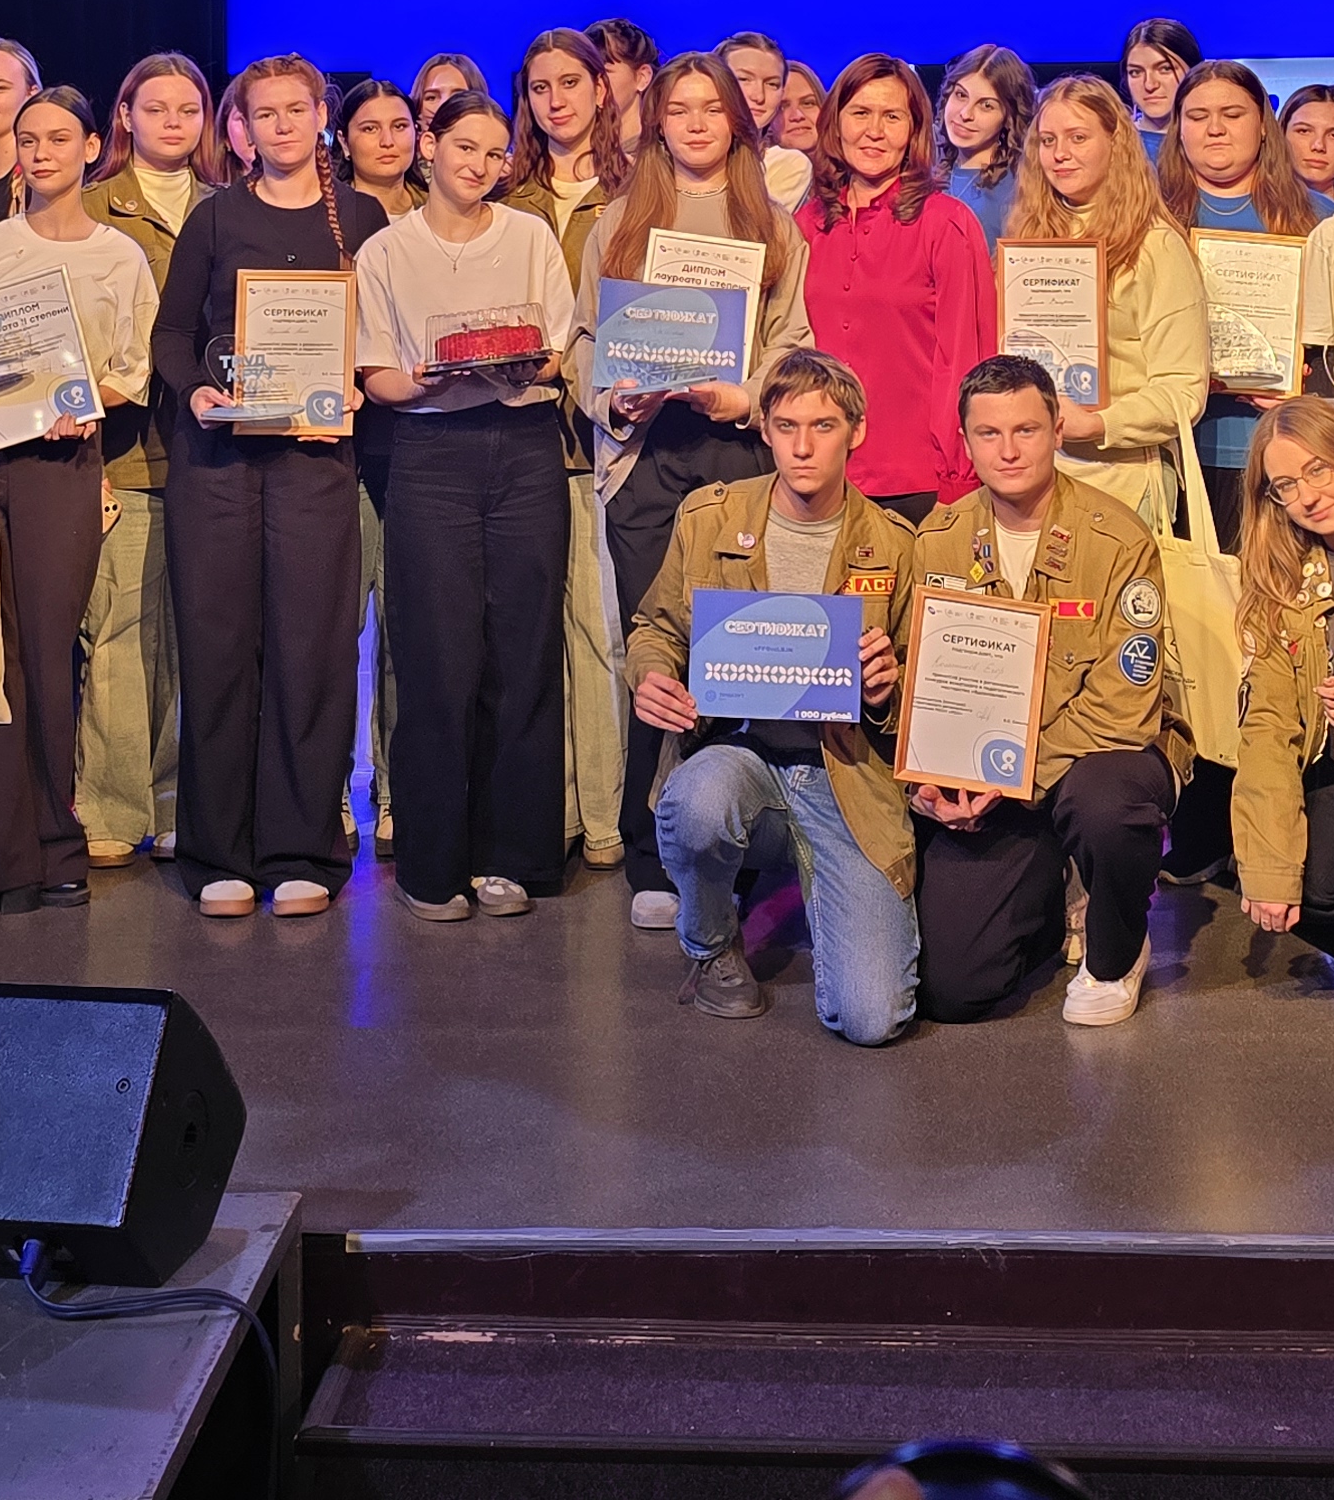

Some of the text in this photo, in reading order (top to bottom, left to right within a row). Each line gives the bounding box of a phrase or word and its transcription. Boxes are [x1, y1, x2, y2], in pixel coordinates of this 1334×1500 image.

[682, 264, 726, 277] ДИПЛОМ
[1216, 268, 1282, 282] СЕРТИФИКАТ
[263, 308, 328, 317] СЕРТИФИКАТ
[942, 634, 1017, 653] СЕРТИФИКАТ
[801, 710, 820, 719] 000
